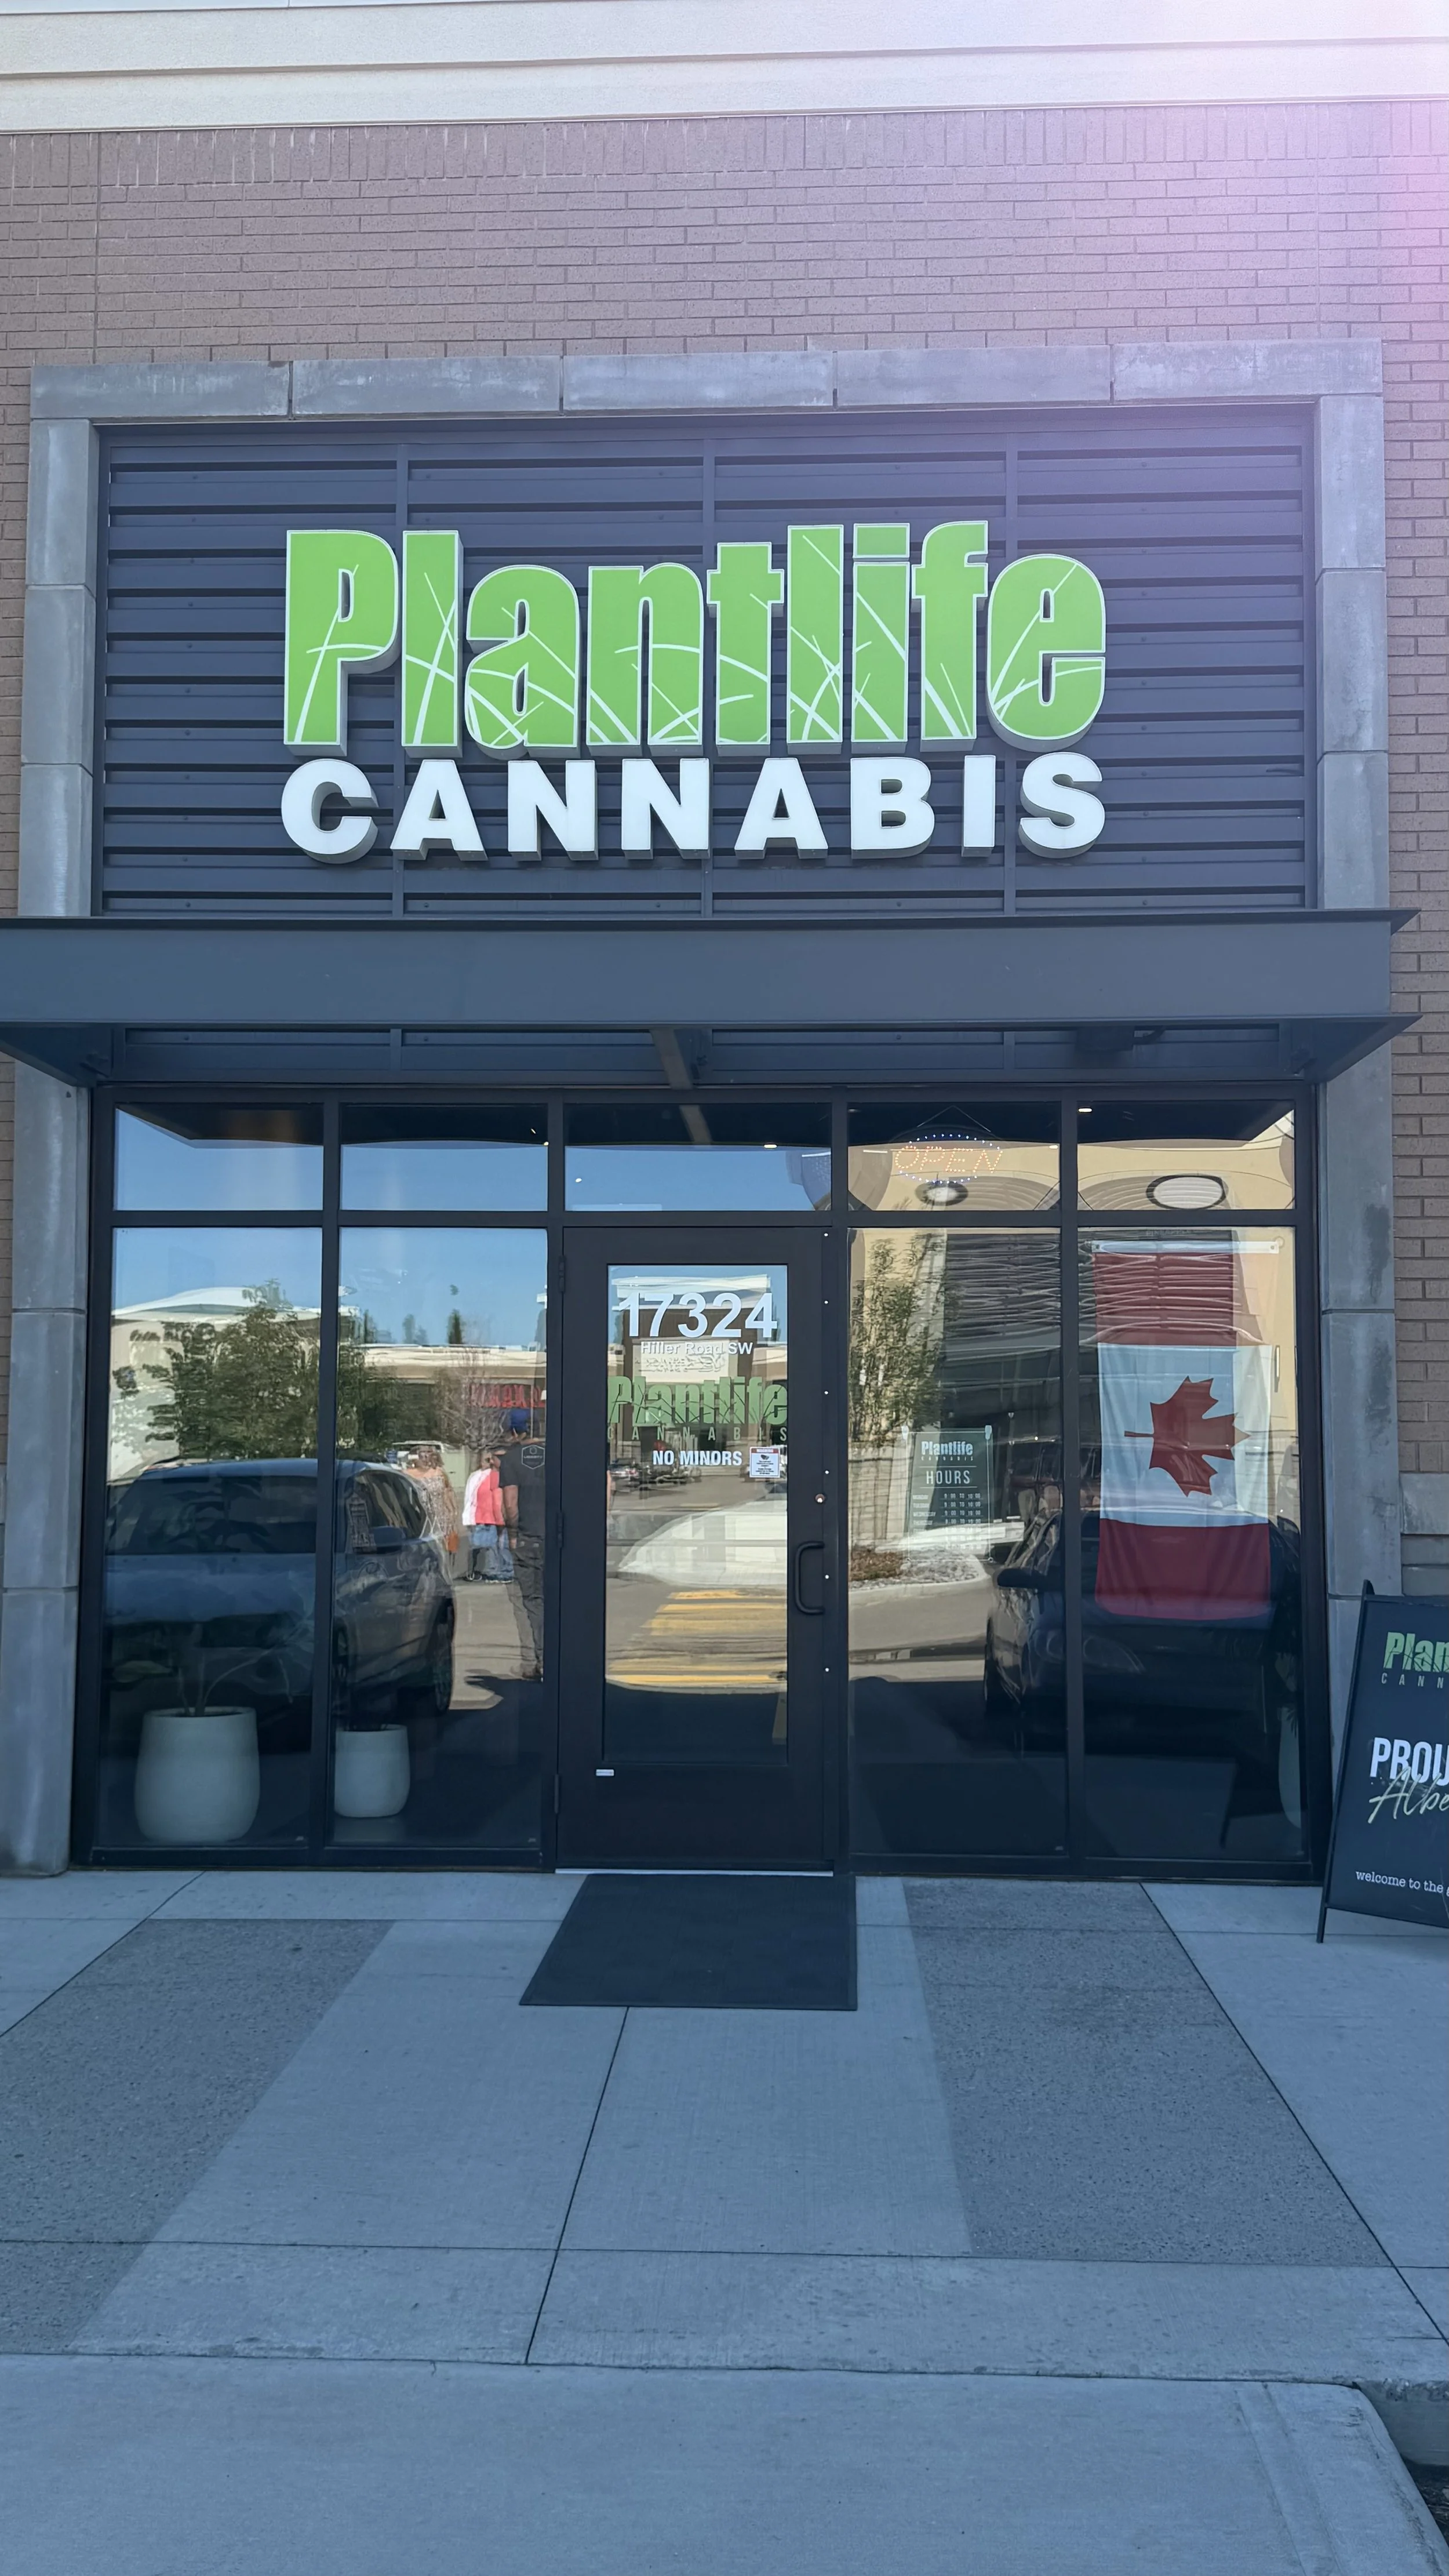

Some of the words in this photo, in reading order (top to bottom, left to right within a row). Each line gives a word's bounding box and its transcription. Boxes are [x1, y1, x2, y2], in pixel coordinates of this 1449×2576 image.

[283, 521, 1106, 757] Plantlife
[281, 754, 1106, 864] CANNABIS
[895, 1145, 1003, 1173] OPEN
[619, 1292, 778, 1338] 17324
[641, 1342, 680, 1354] Hiller
[685, 1342, 723, 1355] Road
[728, 1342, 753, 1355] SW
[607, 1376, 788, 1425] Plantlife
[607, 1426, 787, 1441] CANNABIS
[653, 1450, 674, 1465] NO
[680, 1451, 742, 1466] MINORS
[921, 1441, 974, 1456] Plantlife
[926, 1470, 970, 1485] HOURS
[1381, 1672, 1444, 1689] CANN
[1355, 1871, 1406, 1887] welcome
[1408, 1878, 1421, 1890] to
[1423, 1880, 1444, 1894] the
